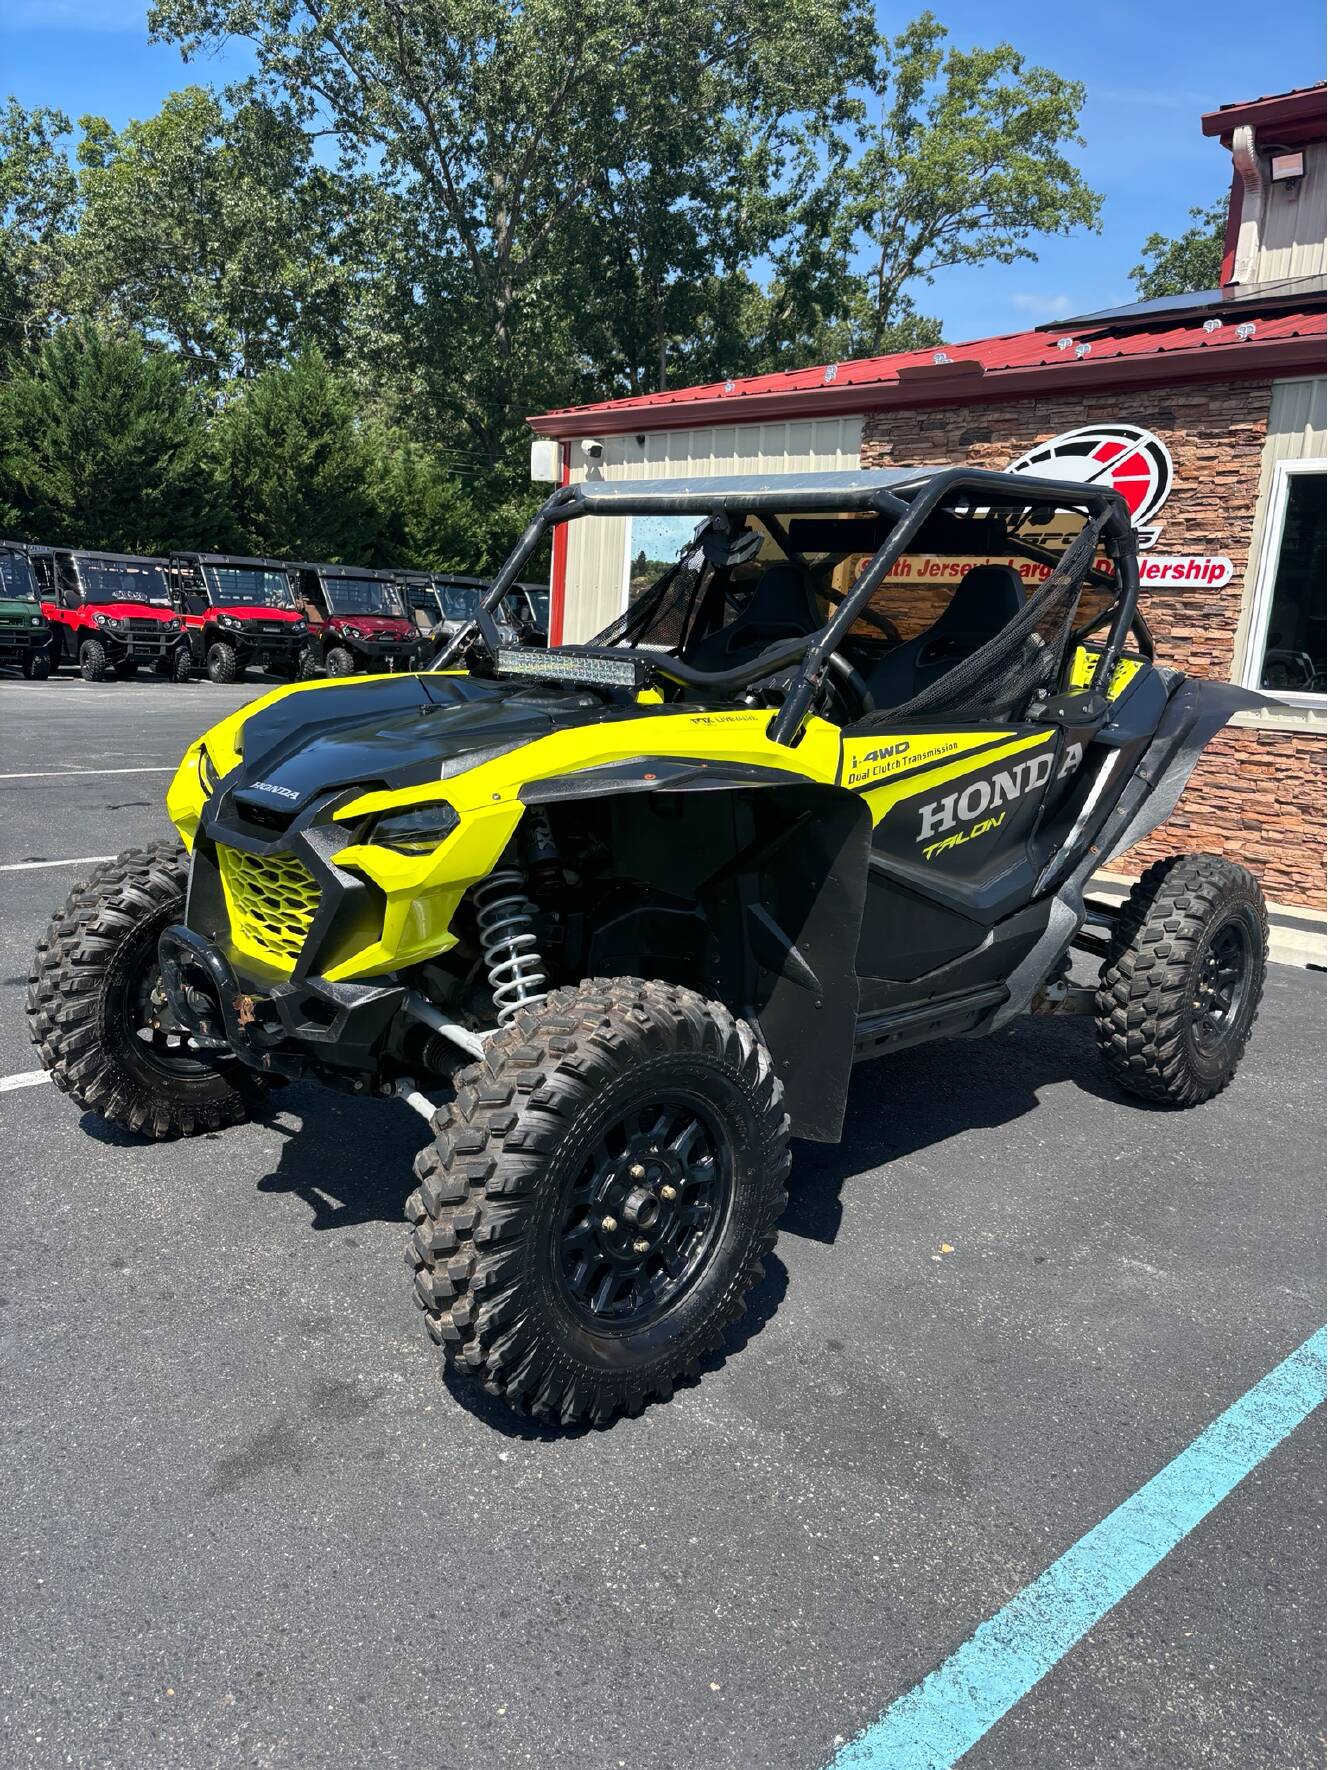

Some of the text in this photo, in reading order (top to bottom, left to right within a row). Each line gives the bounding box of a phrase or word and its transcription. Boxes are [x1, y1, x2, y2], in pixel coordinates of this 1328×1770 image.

[917, 558, 990, 577] Jerse'
[1096, 559, 1226, 584] Dlership
[848, 742, 958, 785] Dual Clutch Transmission
[852, 741, 910, 769] i-4WD
[249, 781, 300, 800] HONDA
[916, 742, 1083, 843] HONDA
[922, 811, 1006, 860] TALON
